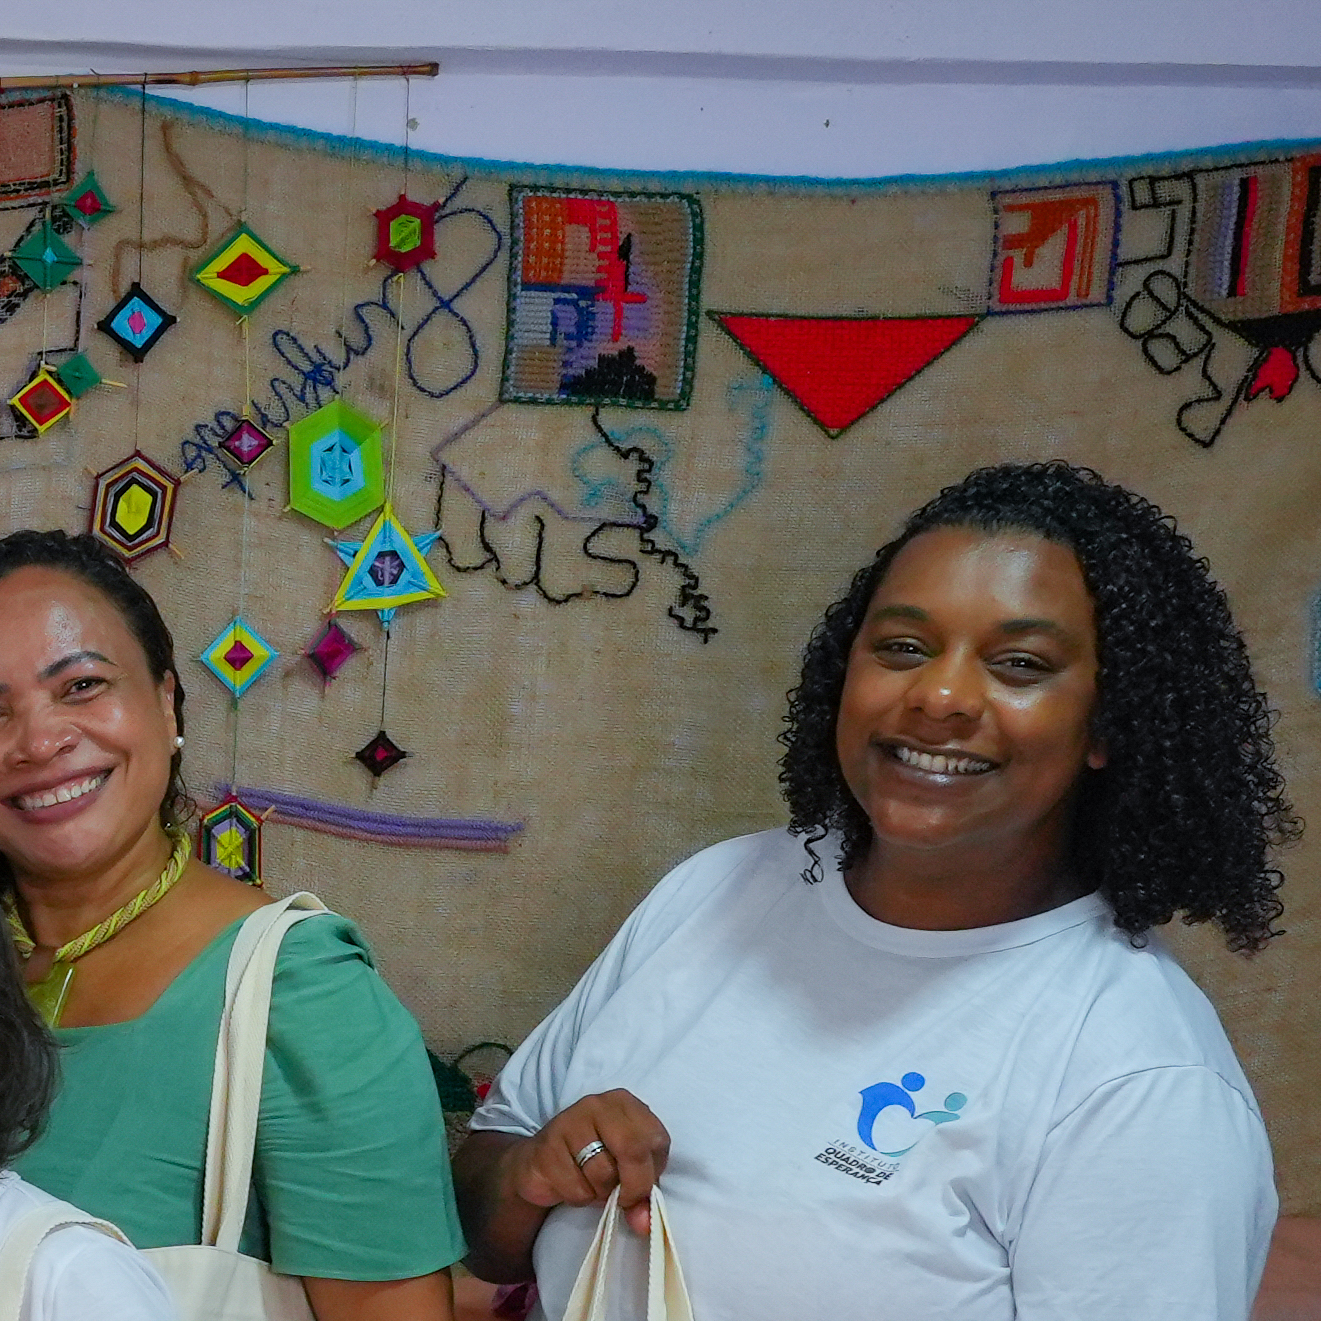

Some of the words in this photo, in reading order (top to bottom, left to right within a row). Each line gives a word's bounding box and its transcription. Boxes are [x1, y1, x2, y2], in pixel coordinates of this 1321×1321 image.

[813, 1152, 884, 1186] ESPERANÇA
[824, 1147, 877, 1174] QUADRO
[875, 1171, 895, 1181] DE
